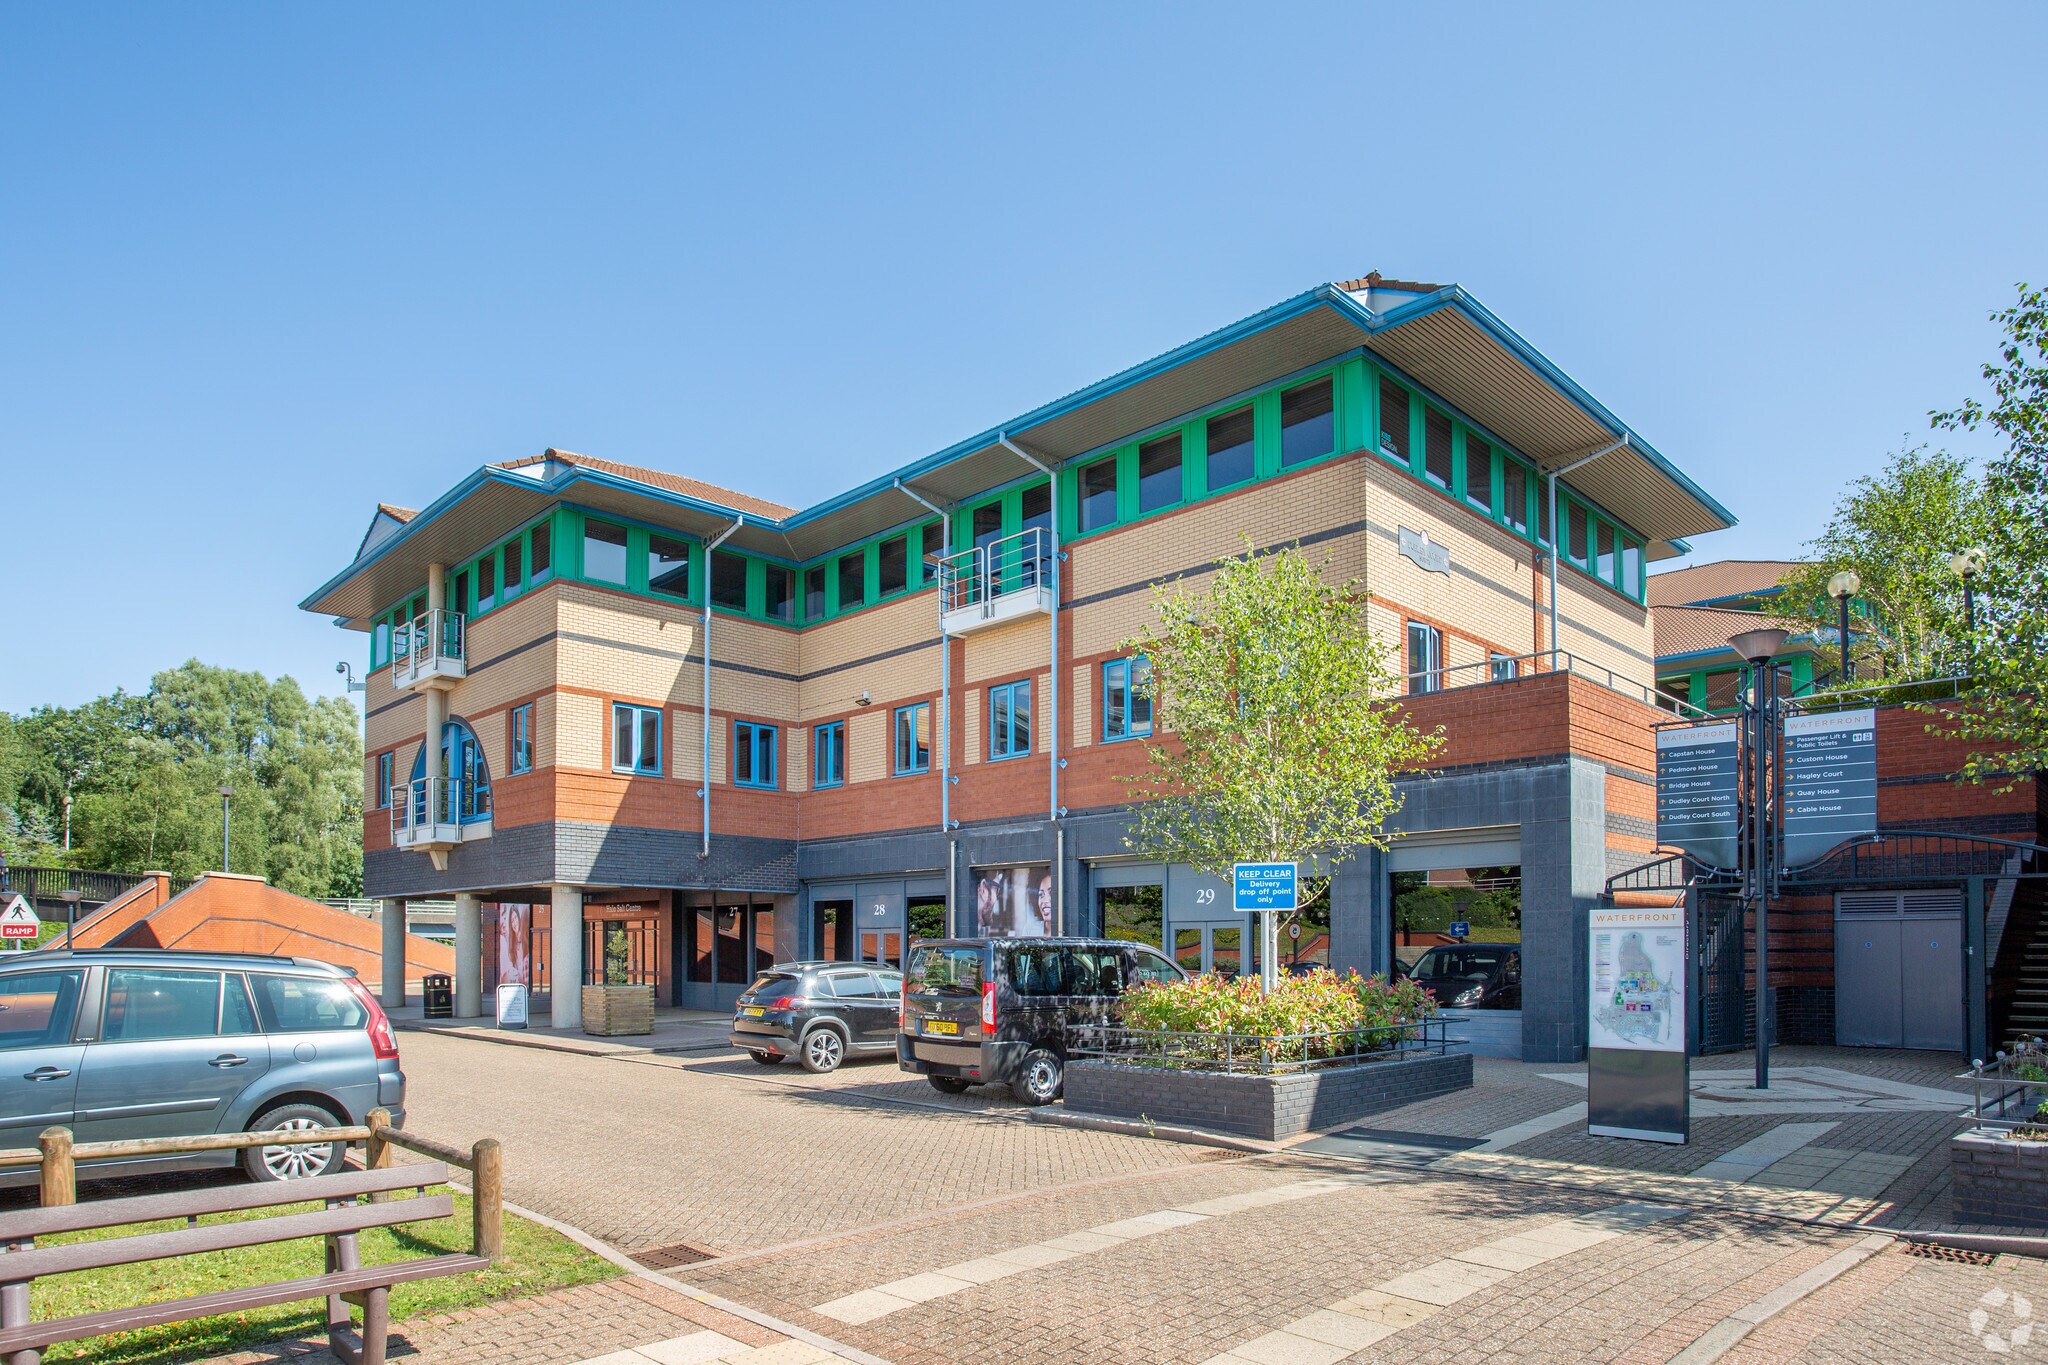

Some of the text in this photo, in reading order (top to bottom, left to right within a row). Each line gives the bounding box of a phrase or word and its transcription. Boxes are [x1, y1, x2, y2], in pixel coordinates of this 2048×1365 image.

[1790, 716, 1868, 730] WATERFRONT
[1662, 730, 1732, 742] WATERFRONT
[1196, 888, 1215, 905] 29
[617, 904, 625, 912] Salt
[626, 904, 642, 912] Centre
[730, 907, 738, 916] 27
[874, 904, 885, 915] 28
[1596, 913, 1677, 922] WATERFRONT
